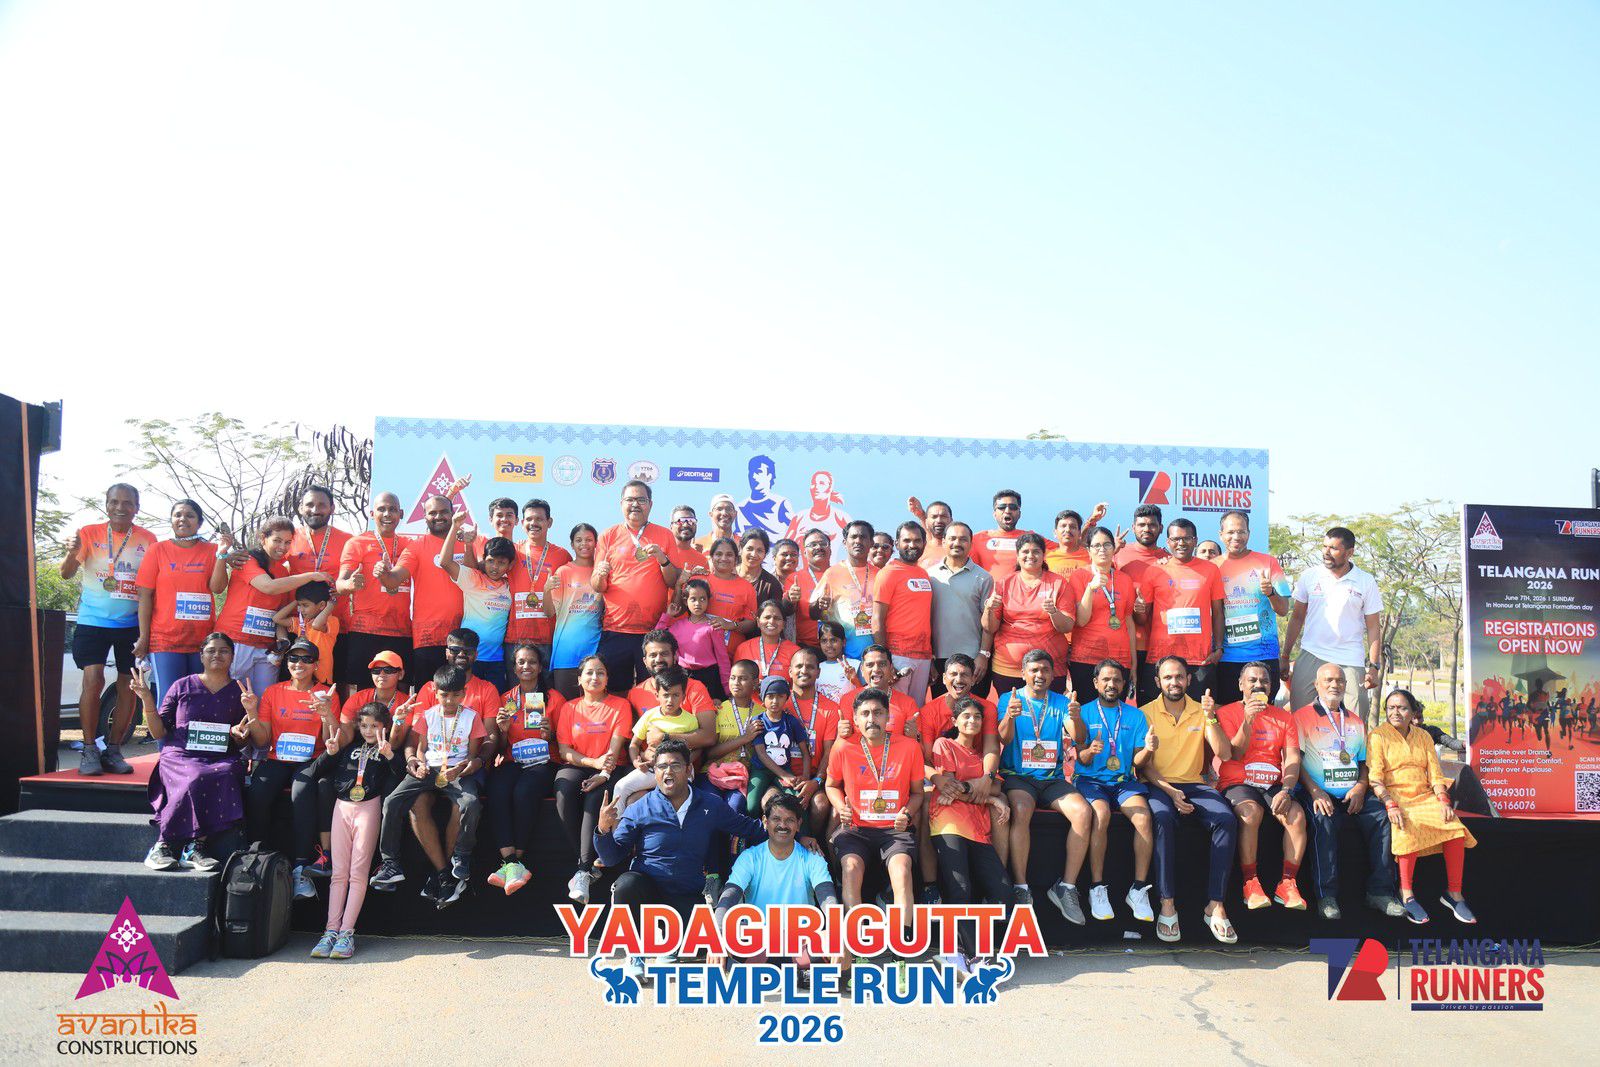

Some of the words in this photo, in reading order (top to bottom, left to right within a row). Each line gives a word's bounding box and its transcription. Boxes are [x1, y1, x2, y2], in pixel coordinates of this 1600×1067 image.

[1182, 472, 1252, 489] TELANGANA
[1182, 489, 1252, 508] RUNNERS
[1478, 565, 1567, 579] TELANGANA
[1571, 568, 1600, 580] RUN
[1527, 581, 1553, 590] 2026
[187, 603, 210, 611] 10162
[1235, 624, 1258, 633] 50154
[1485, 621, 1595, 636] REGISTRATIONS
[1499, 639, 1541, 653] OPEN
[1545, 640, 1583, 654] NOW
[200, 733, 226, 742] 50206
[287, 744, 311, 753] 10095
[523, 746, 547, 755] 10114
[1256, 773, 1278, 781] 20118
[1484, 788, 1536, 797] 849493010
[1493, 801, 1535, 810] 96166076
